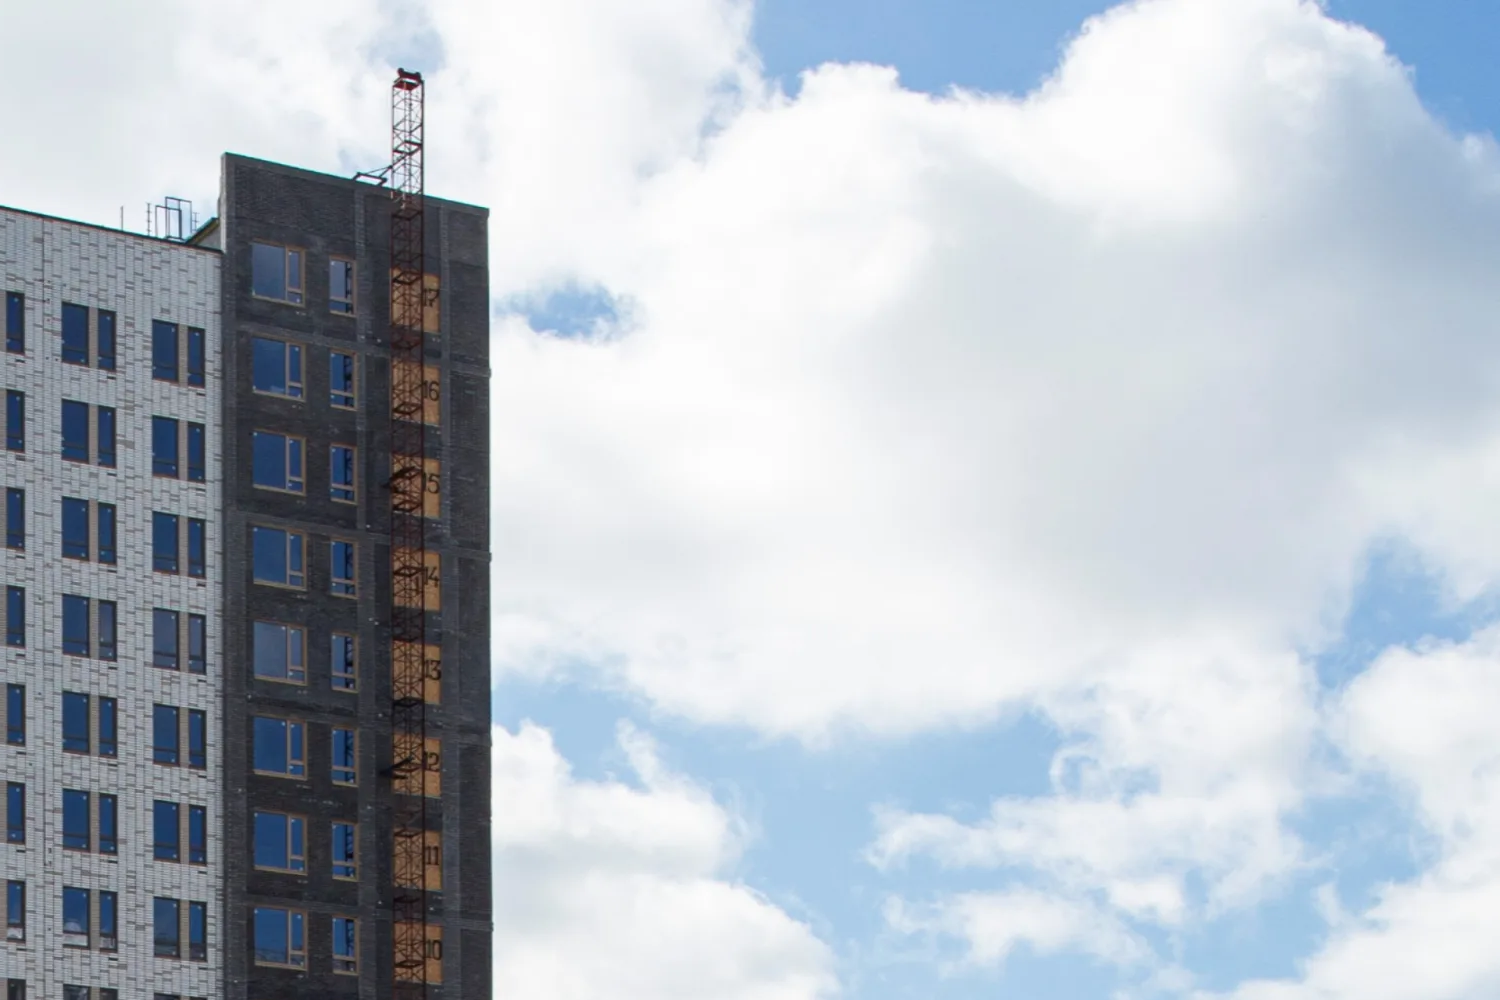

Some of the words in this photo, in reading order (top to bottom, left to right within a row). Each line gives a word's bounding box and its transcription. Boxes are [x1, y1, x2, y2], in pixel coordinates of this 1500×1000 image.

[420, 380, 440, 402] 16
[422, 566, 440, 588] 14
[423, 658, 441, 681] 13
[422, 751, 440, 773] 12
[425, 845, 439, 866] 11
[424, 939, 442, 961] 10
